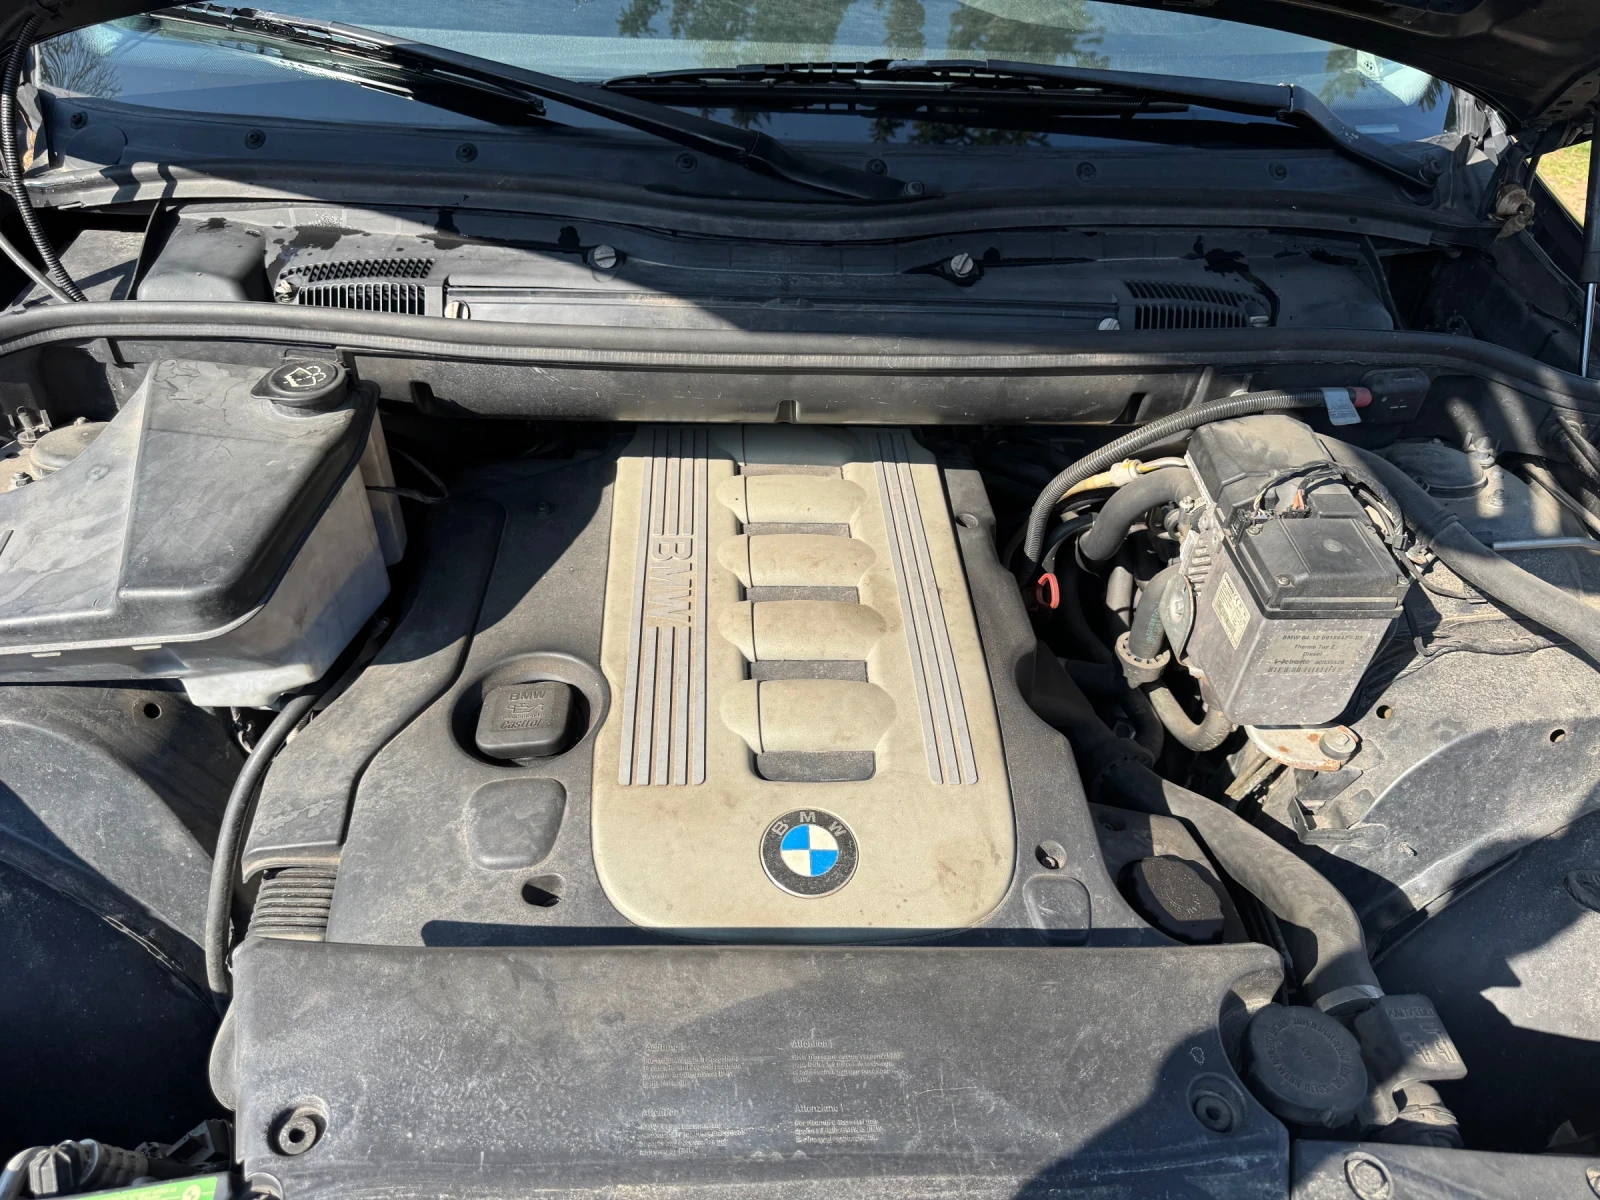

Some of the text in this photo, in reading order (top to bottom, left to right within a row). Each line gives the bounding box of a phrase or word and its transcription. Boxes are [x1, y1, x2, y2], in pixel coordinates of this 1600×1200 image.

[648, 537, 693, 625] BMW
[509, 690, 547, 701] BMW
[499, 718, 543, 730] Castrol
[771, 811, 847, 840] BMW
[1304, 1082, 1330, 1094] HEISS
[794, 1103, 839, 1113] Attenzione
